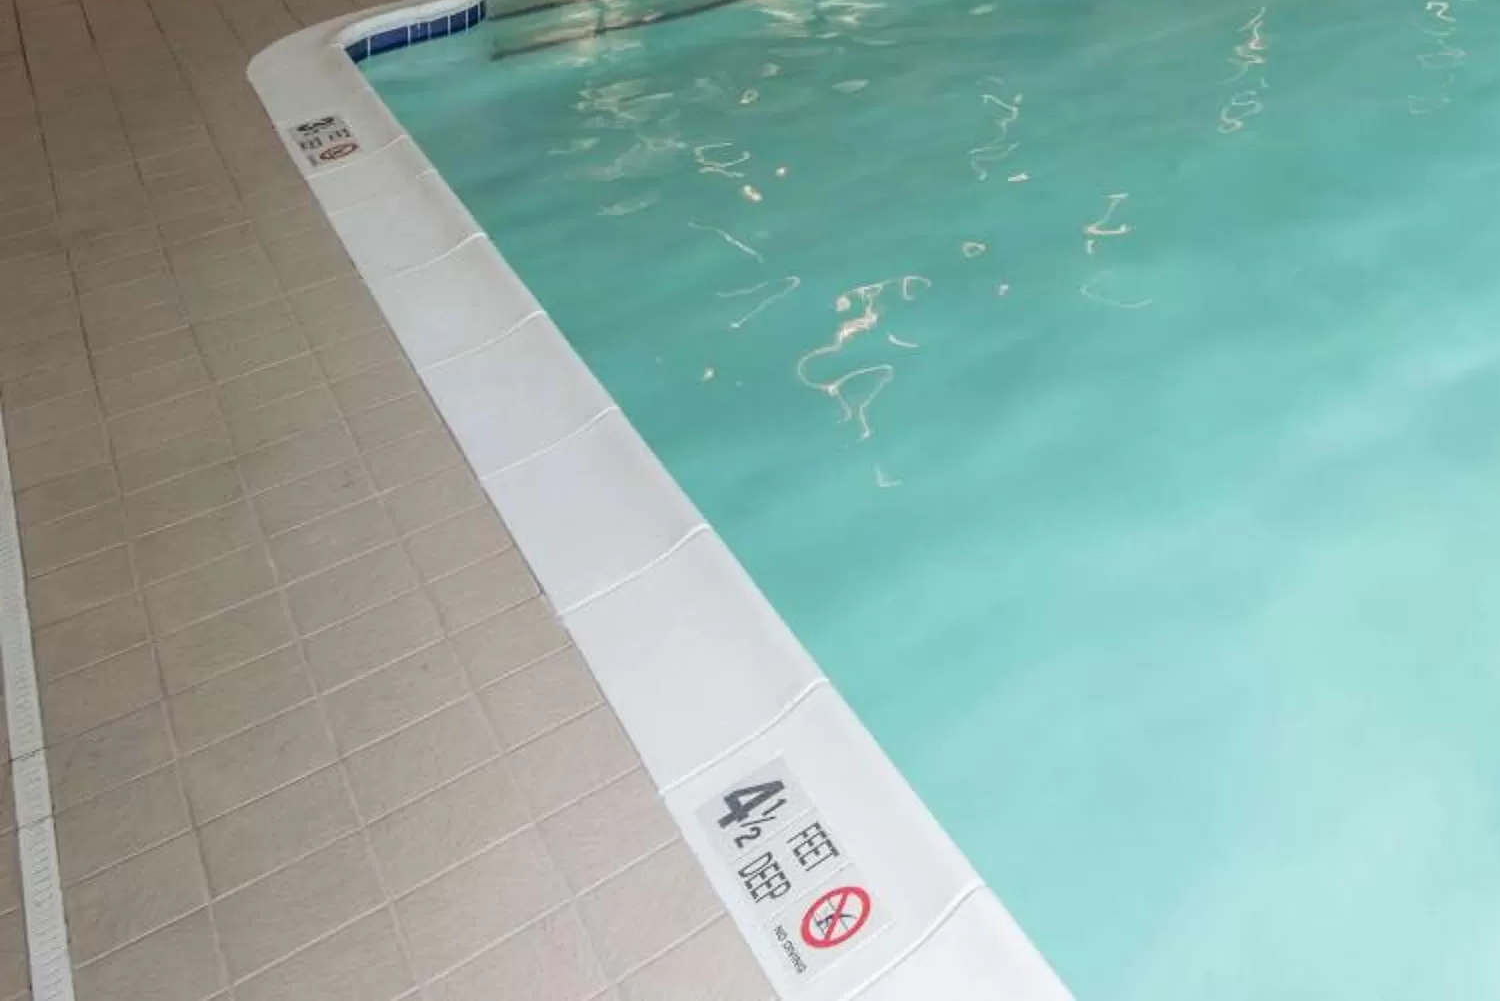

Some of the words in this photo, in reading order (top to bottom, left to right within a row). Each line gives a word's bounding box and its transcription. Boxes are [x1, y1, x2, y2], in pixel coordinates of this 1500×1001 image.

[786, 821, 841, 872] FEET
[737, 851, 792, 903] DEEP
[773, 923, 788, 942] NO
[783, 940, 807, 974] DIVING
